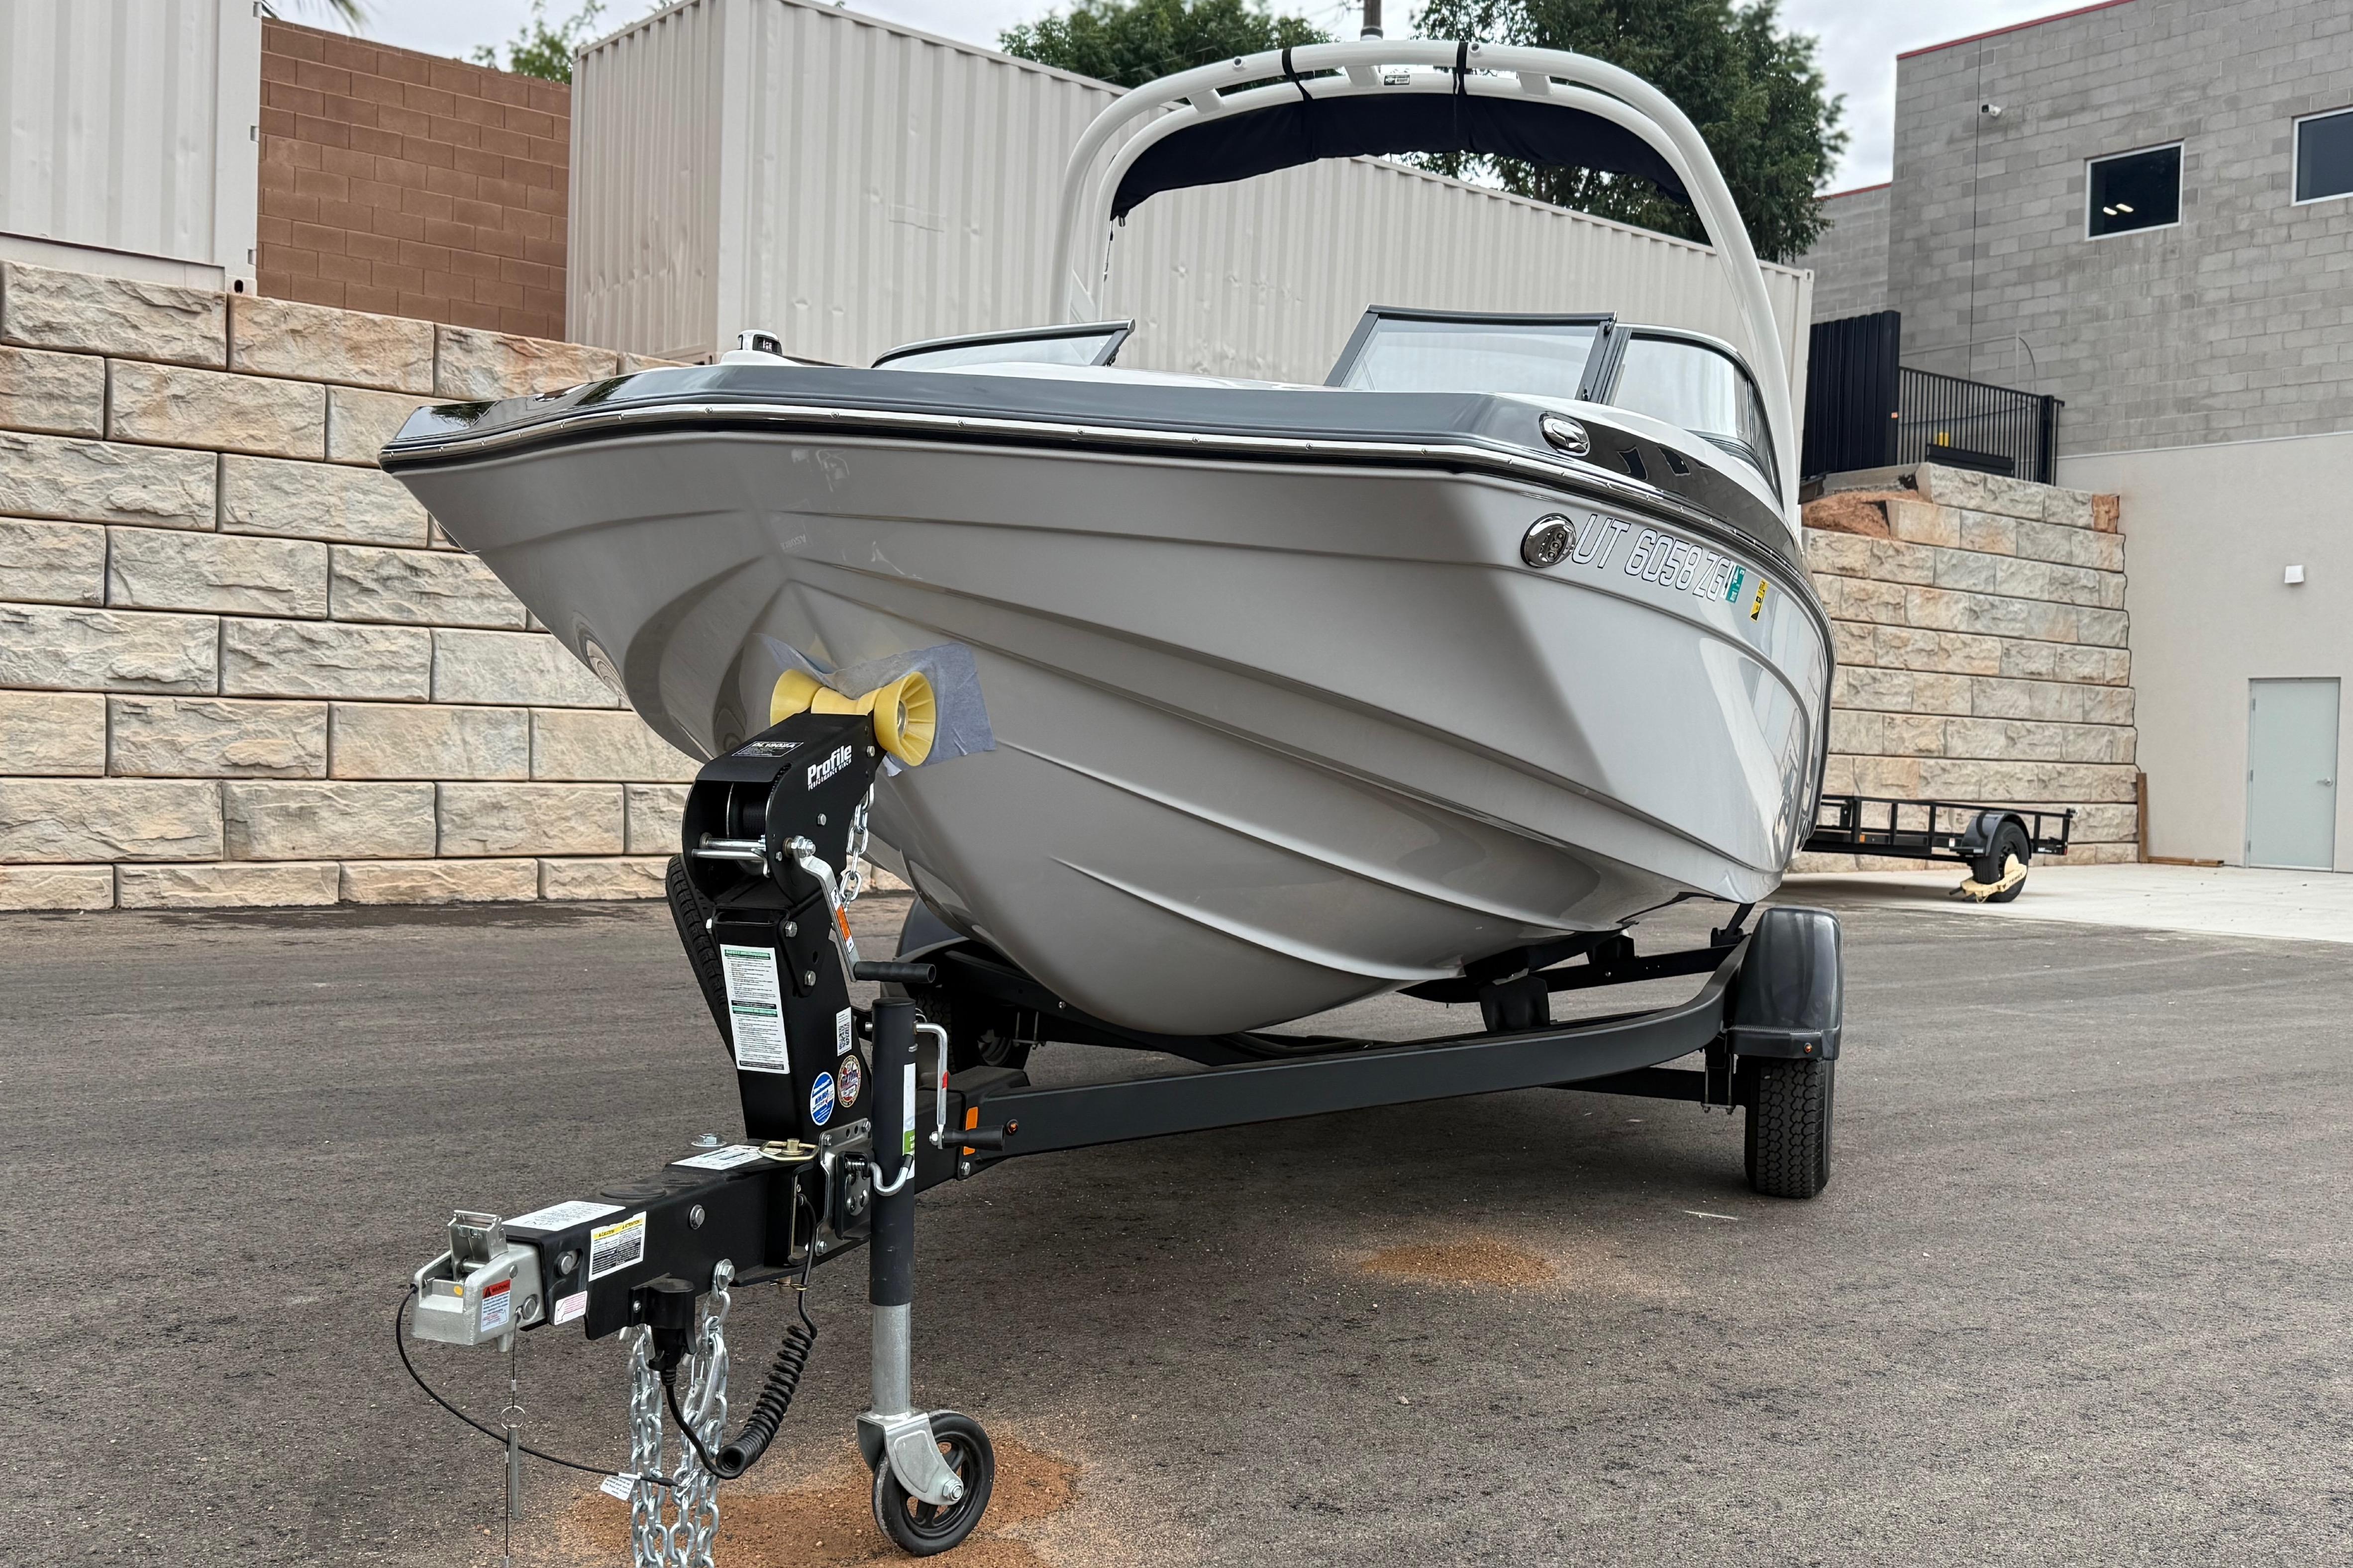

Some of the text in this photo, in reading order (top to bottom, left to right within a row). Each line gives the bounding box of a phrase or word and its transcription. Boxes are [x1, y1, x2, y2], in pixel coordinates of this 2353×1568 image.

[1572, 514, 1632, 569] UT
[1625, 528, 1703, 591] 6058
[808, 745, 852, 785] Profile
